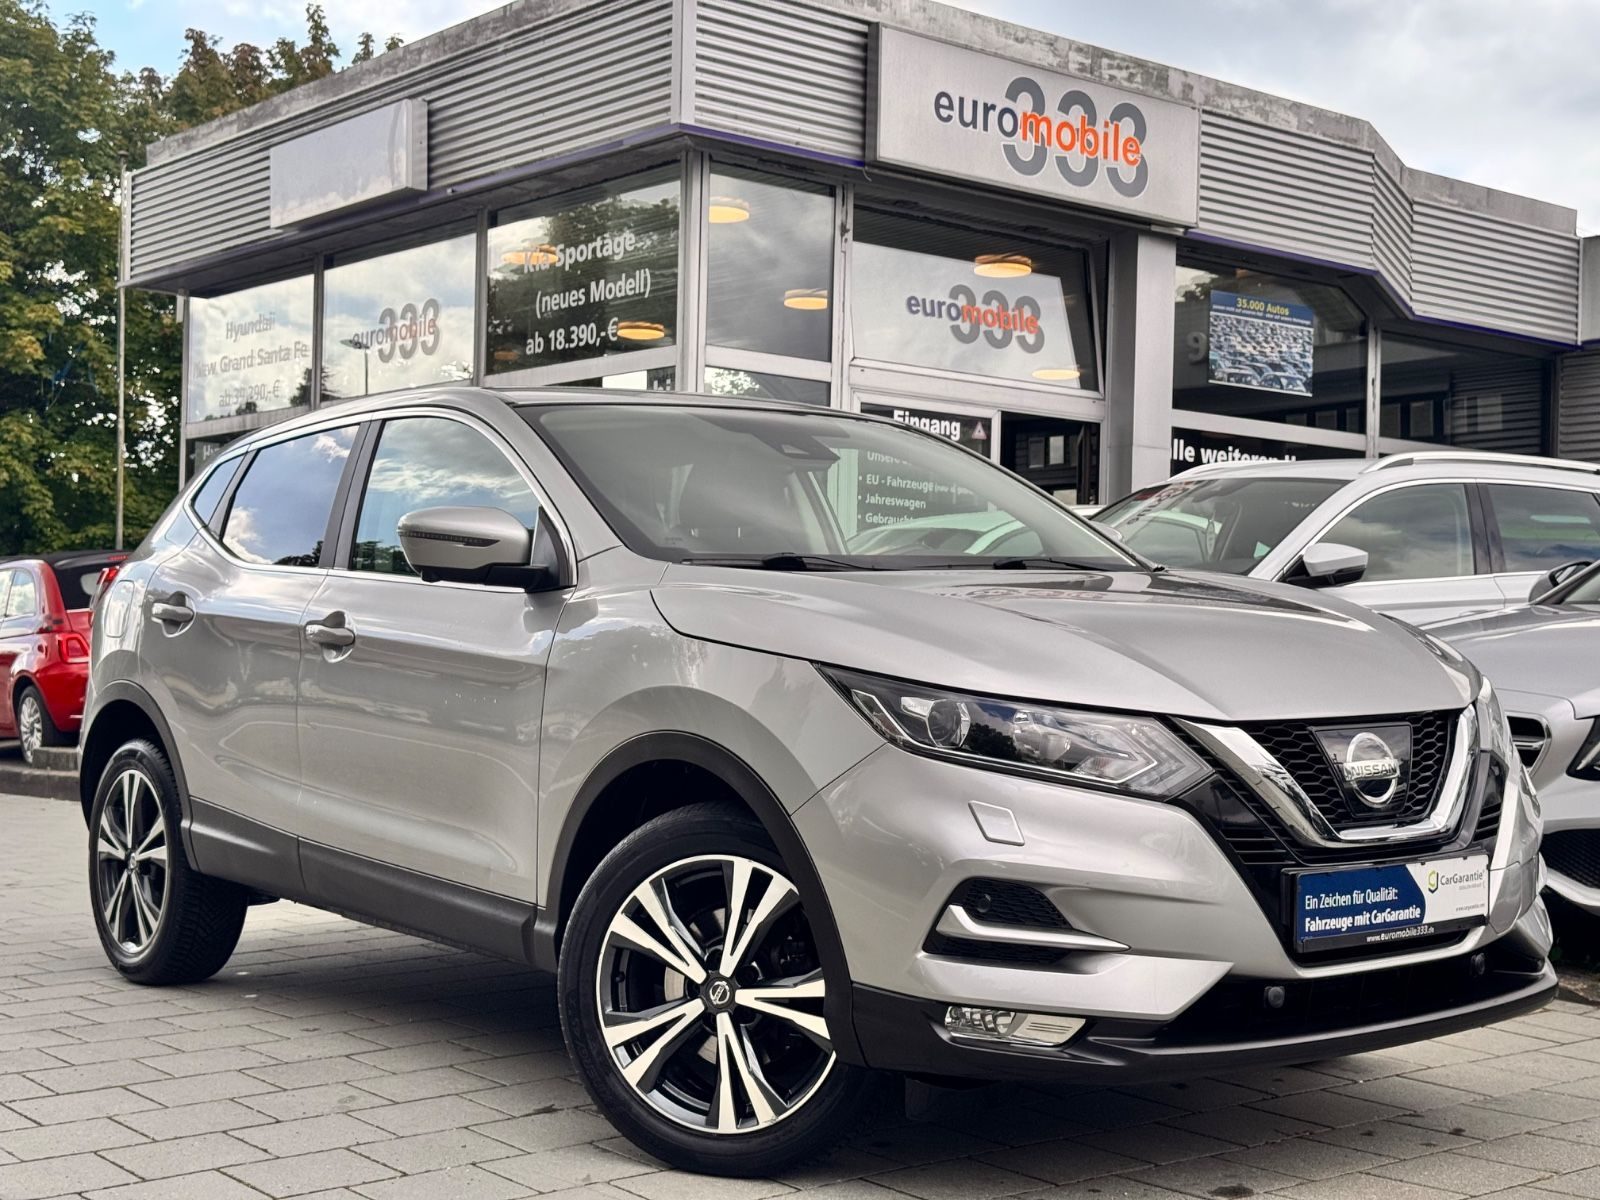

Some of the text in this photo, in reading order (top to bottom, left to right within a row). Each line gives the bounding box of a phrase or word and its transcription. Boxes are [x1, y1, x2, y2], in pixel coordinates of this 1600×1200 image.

[934, 76, 1149, 198] euromobile 333
[555, 231, 637, 271] Sportage
[535, 267, 651, 319] (neues Modell)
[906, 284, 1045, 354] euromobile 333
[1236, 297, 1265, 312] 35.000
[1266, 303, 1290, 316] Autos
[225, 311, 276, 343] Hyundai
[352, 298, 440, 363] euromobile 333
[526, 331, 544, 355] ab
[219, 349, 255, 373] Grand
[257, 345, 292, 367] Santa
[293, 340, 310, 359] Fe
[219, 387, 234, 408] ab
[866, 473, 880, 485] EU
[886, 475, 934, 493] Fahrzeuge
[865, 493, 927, 510] Jahreswagen
[1350, 763, 1396, 778] NISSAN
[1305, 886, 1398, 910] Ein Zeichen für Qualität:
[1305, 904, 1421, 932] Fahrzeuge mit CarGarantie
[1366, 925, 1435, 942] www.euromobile333.de
